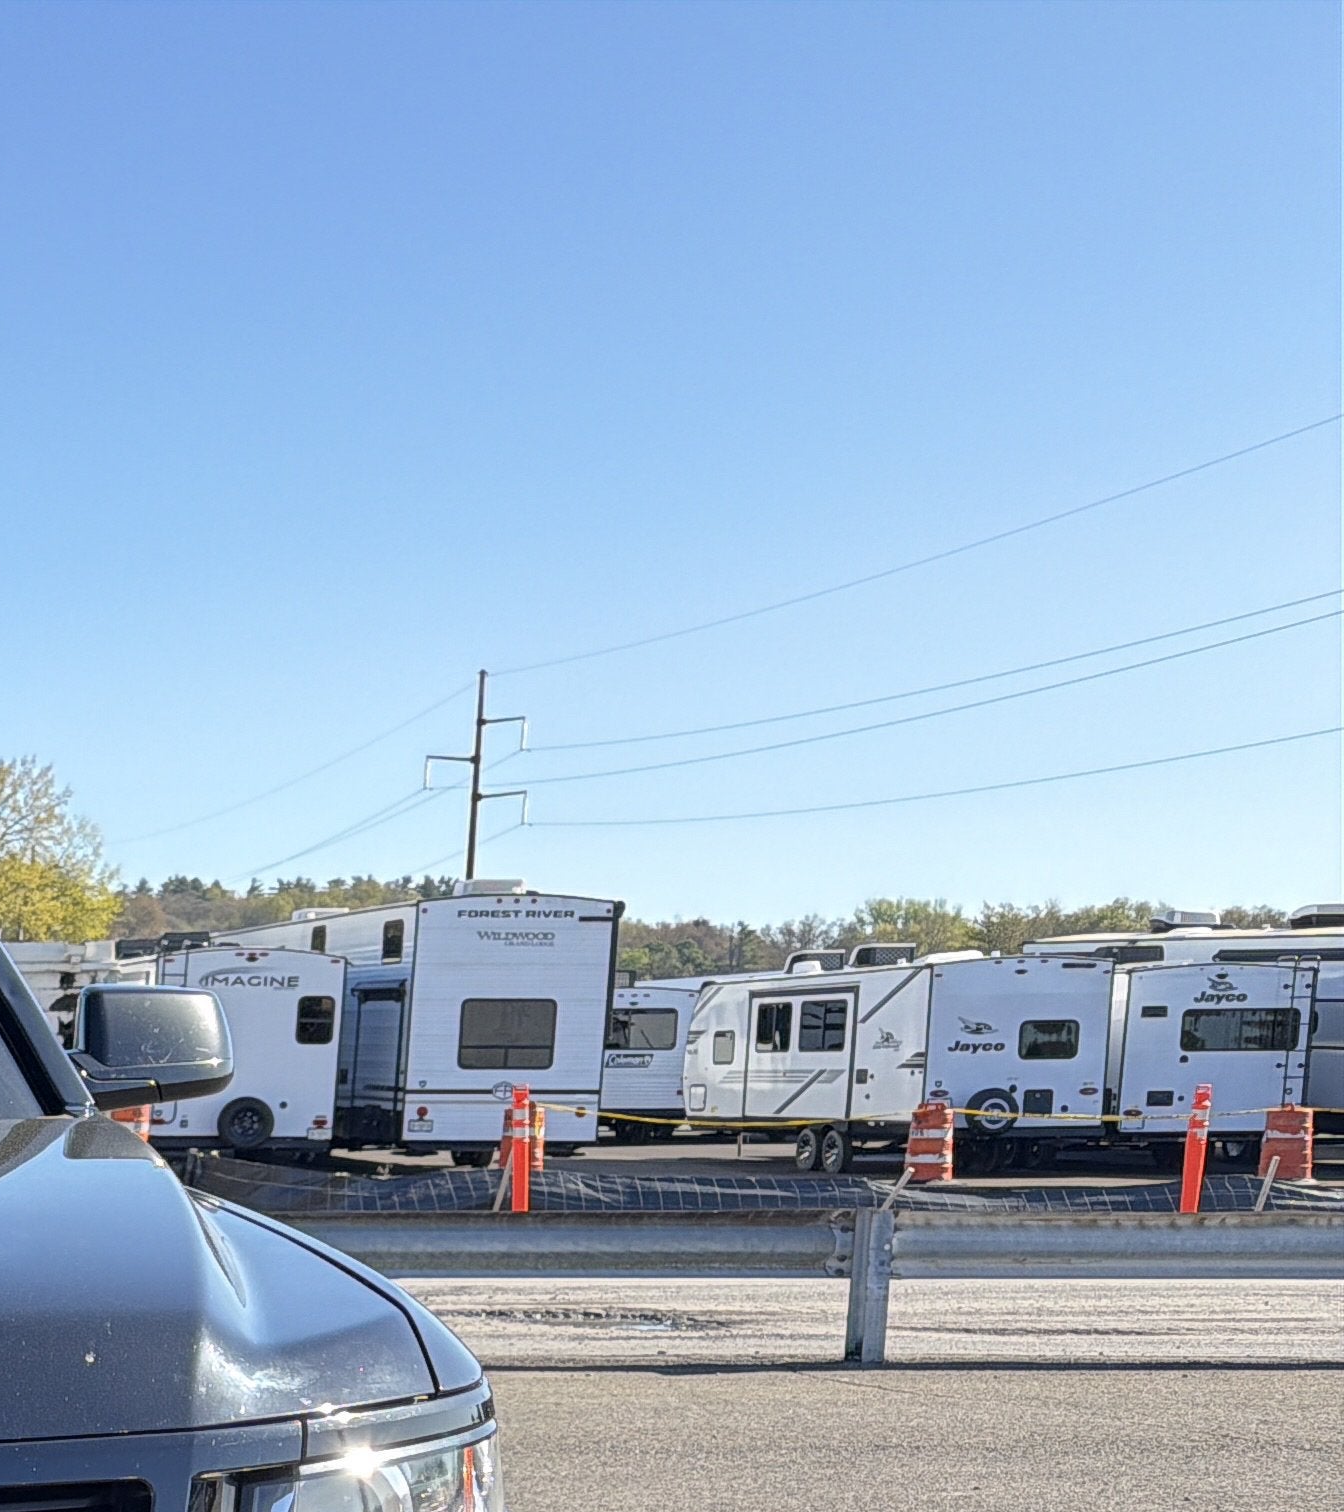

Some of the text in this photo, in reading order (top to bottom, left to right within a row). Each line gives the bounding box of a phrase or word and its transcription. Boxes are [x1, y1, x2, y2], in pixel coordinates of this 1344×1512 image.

[457, 909, 575, 919] FOREST RIVER
[477, 931, 556, 941] WILDWOOD
[204, 975, 300, 988] IMAGINE
[1193, 990, 1248, 1006] Jayco
[947, 1040, 1006, 1054] Jayco
